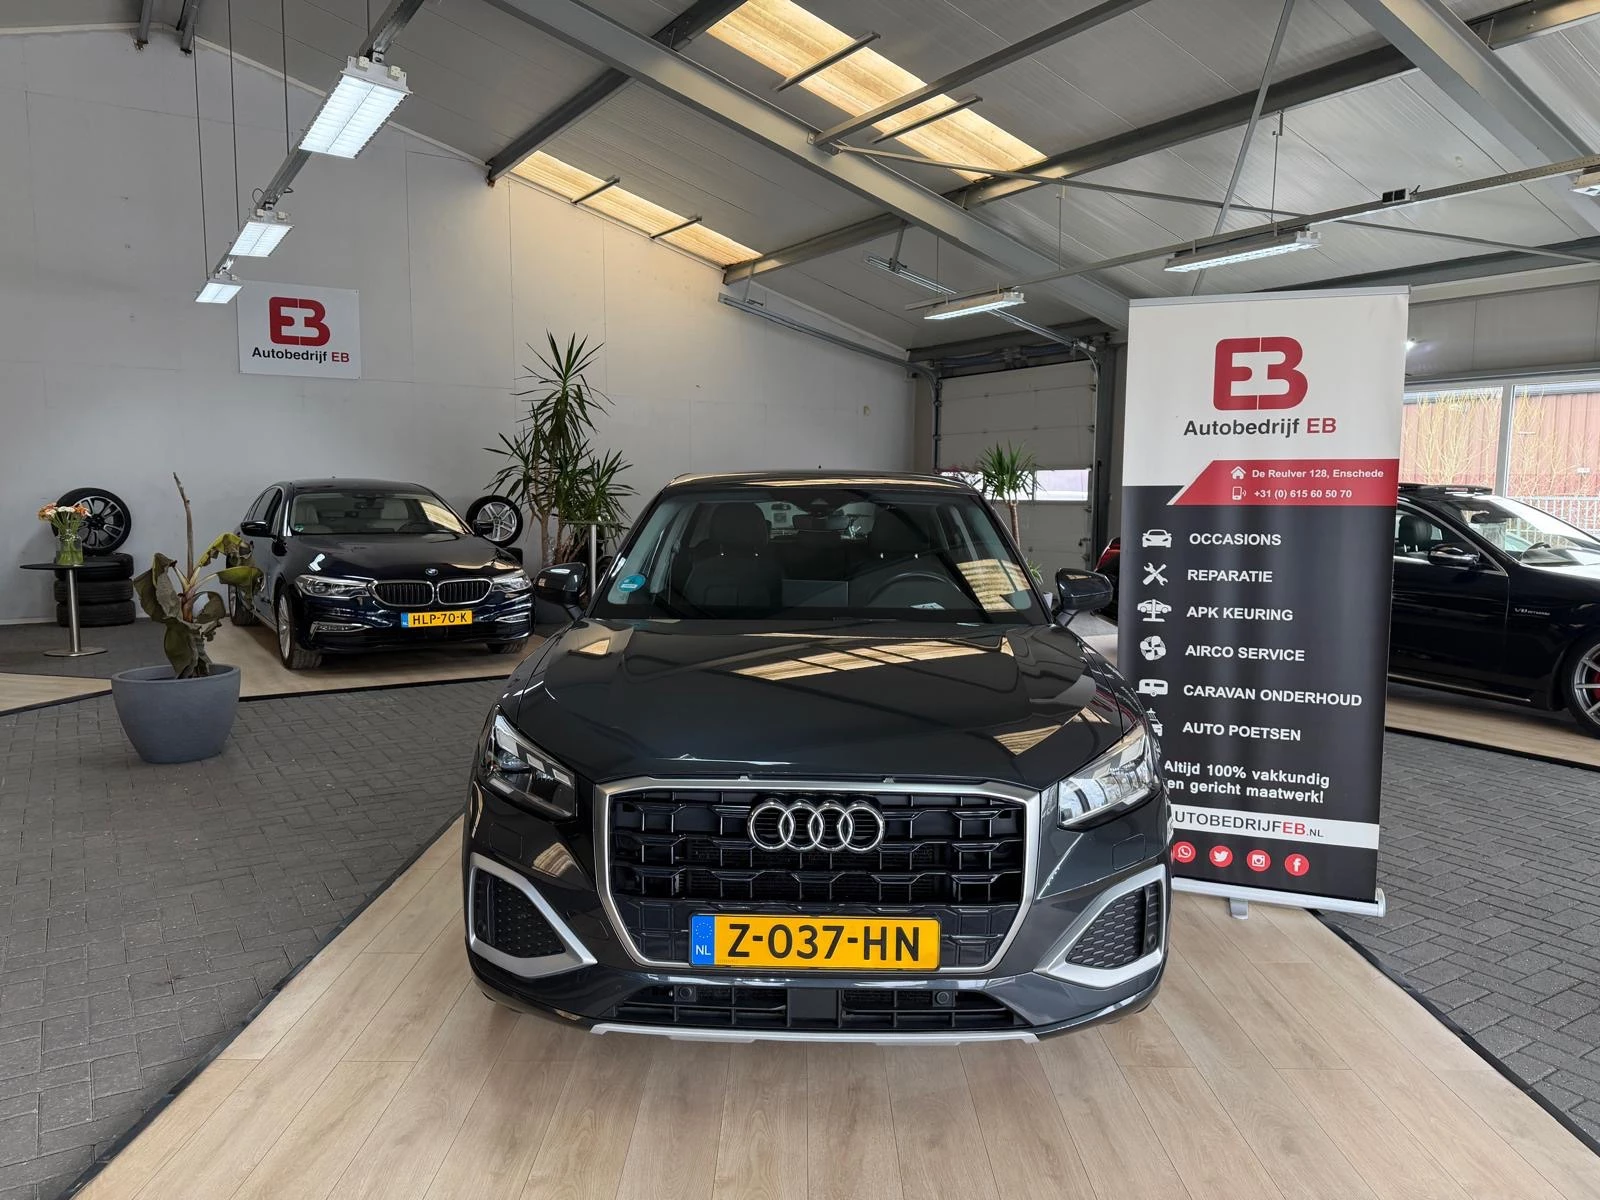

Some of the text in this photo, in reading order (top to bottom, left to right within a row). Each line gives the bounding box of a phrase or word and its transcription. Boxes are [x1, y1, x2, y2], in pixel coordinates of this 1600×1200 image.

[252, 347, 350, 364] Autobedrijf EB
[1183, 417, 1337, 438] Autobedrijf EB
[1251, 469, 1384, 479] De Reulver 128, Enschede
[1254, 489, 1353, 499] +31 (0) 615 60 50 70
[1189, 533, 1282, 546] OCCASIONS
[1187, 569, 1273, 583] REPARATIE
[412, 612, 467, 625] HLP-70-K
[1186, 606, 1293, 621] APK KEURING
[1185, 645, 1305, 662] AIRCO SERVICE
[1183, 684, 1362, 706] CARAVAN ONDERHOUD
[1182, 722, 1301, 741] AUTO POETSEN
[1164, 760, 1330, 788] Altijd 100% vakkundig
[1167, 779, 1324, 803] en gericht maatwerk!
[1174, 810, 1324, 838] UTOBEDRIJFEB.NL
[695, 944, 711, 956] NL
[727, 923, 920, 961] Z-037-HN
